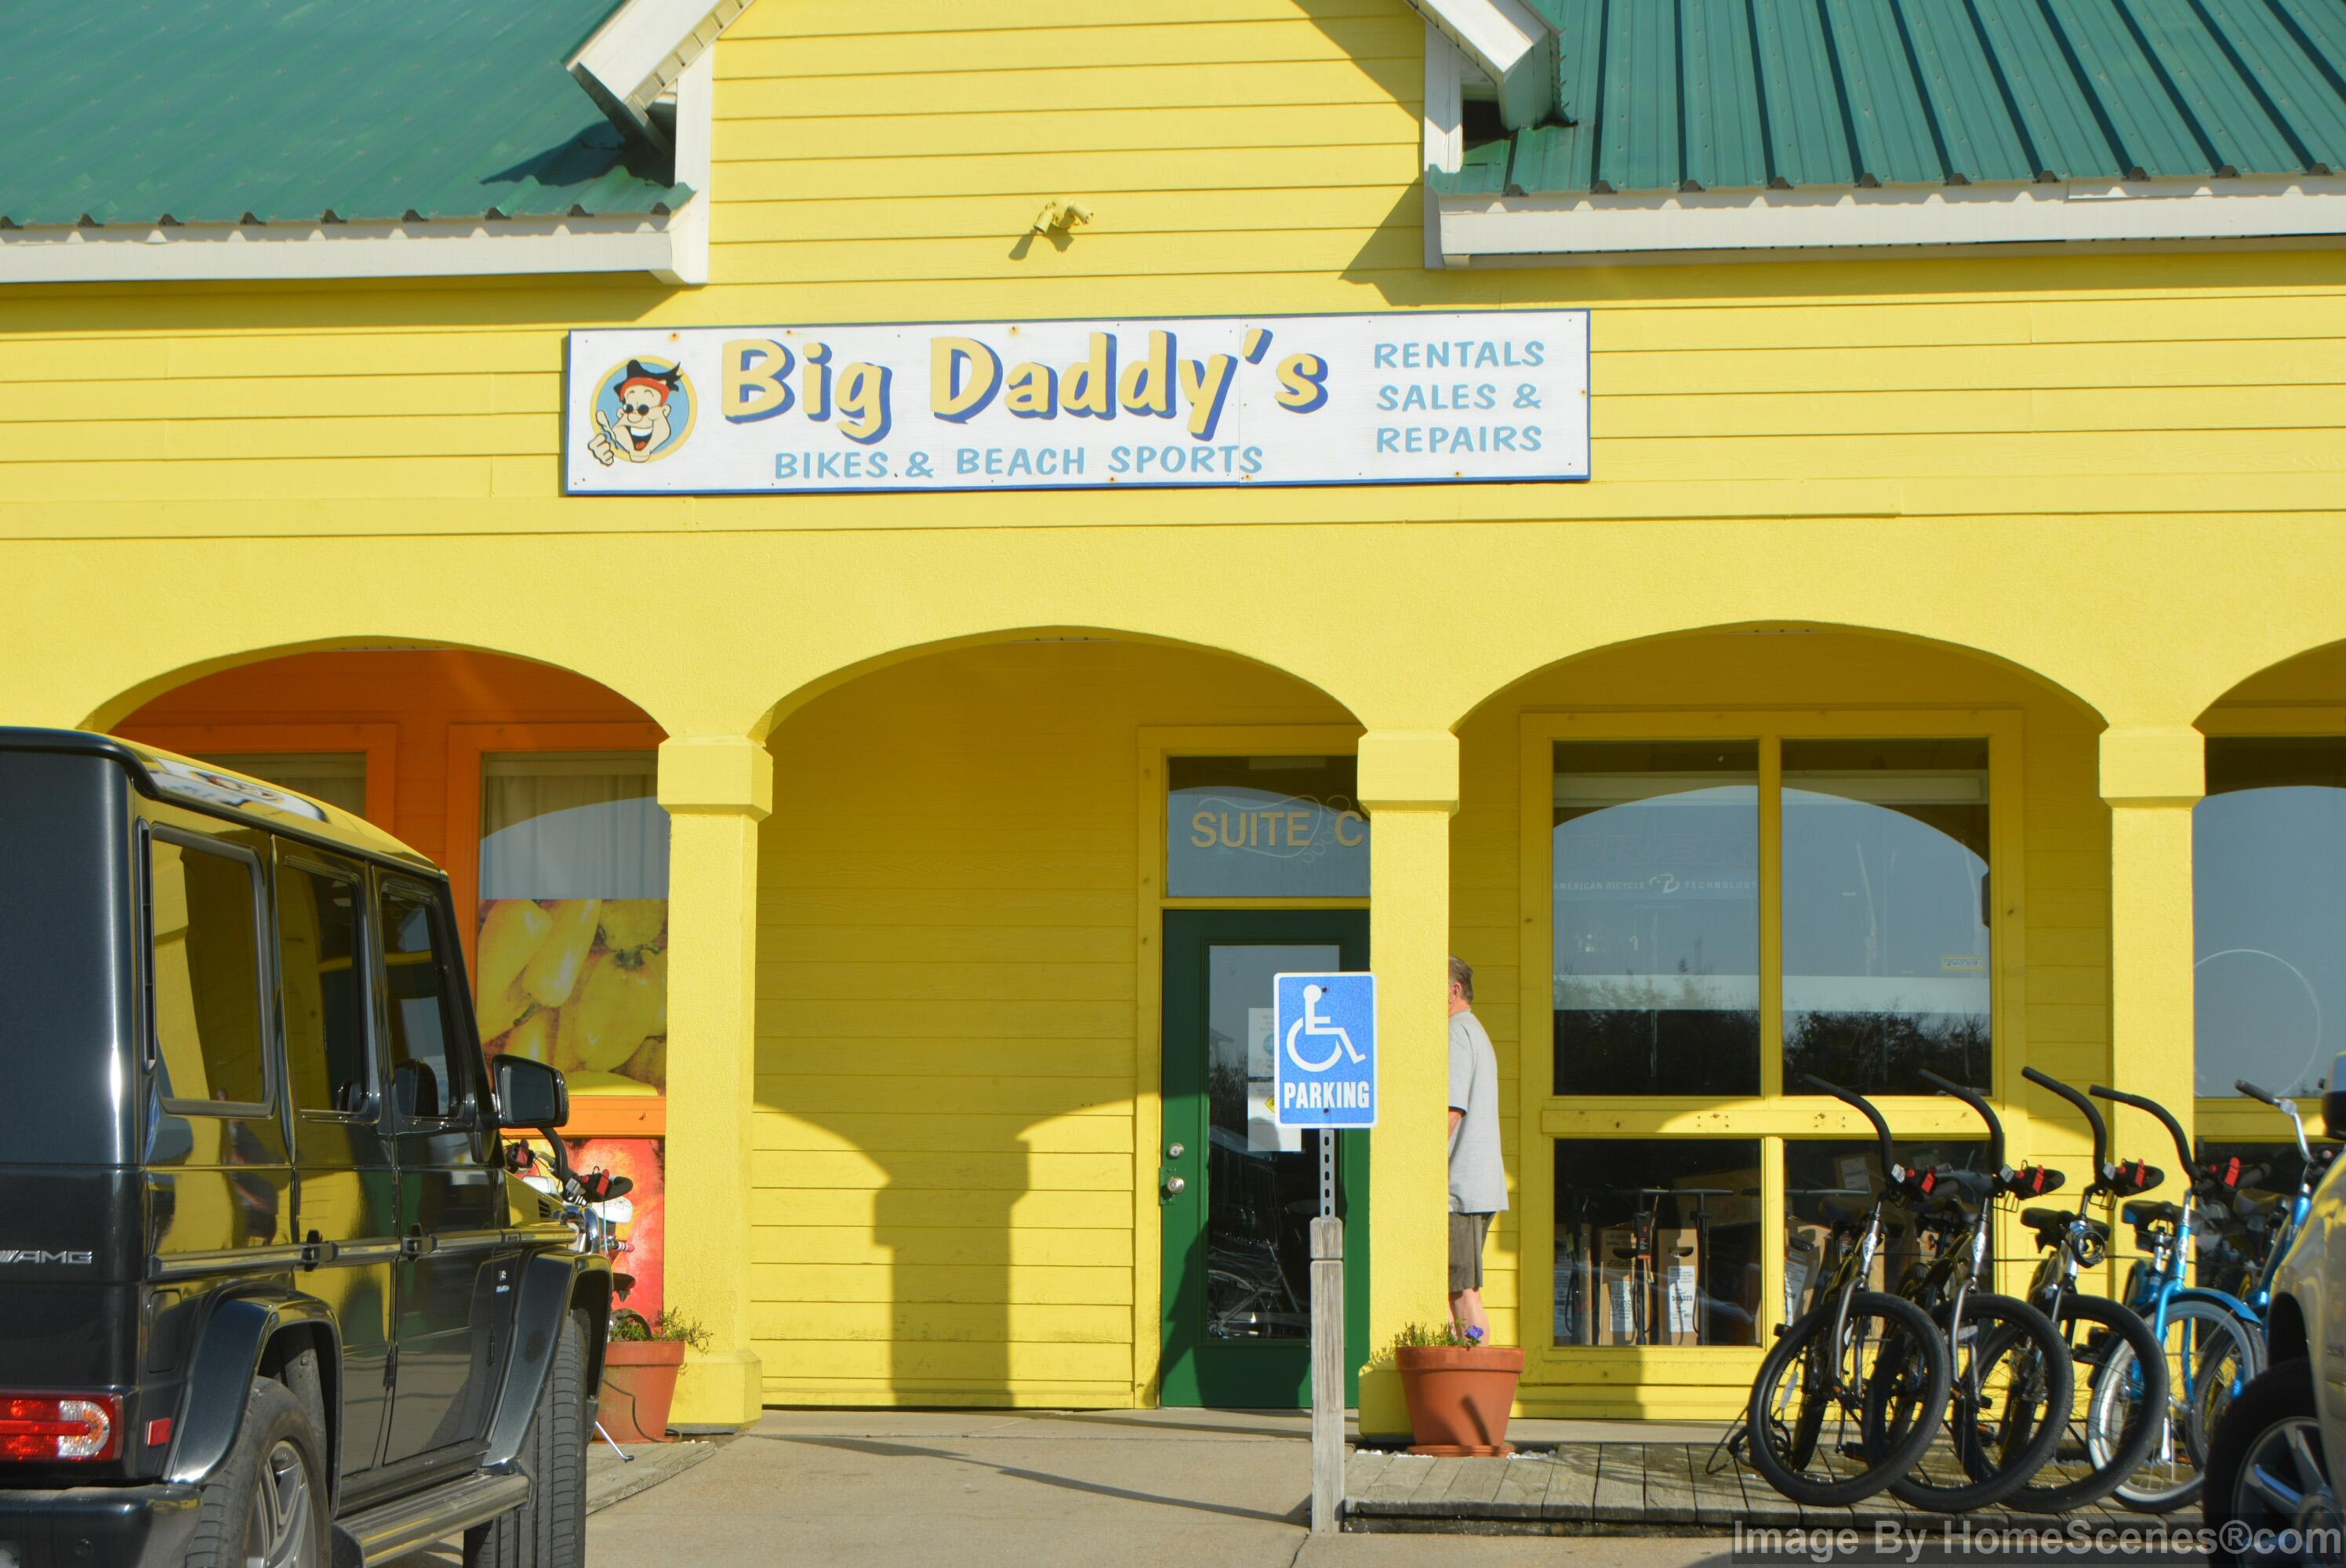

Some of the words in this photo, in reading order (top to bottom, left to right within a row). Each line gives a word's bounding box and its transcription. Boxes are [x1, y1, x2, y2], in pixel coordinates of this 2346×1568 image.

[1375, 341, 1545, 369] RENTALS
[721, 339, 892, 445] Big
[930, 328, 1328, 441] Daddy's
[1376, 383, 1496, 412] SALES
[1513, 383, 1542, 409] &
[1377, 425, 1542, 454] REPAIRS
[775, 452, 888, 479] BIKES
[906, 452, 935, 478] &
[956, 448, 1085, 477] BEACH
[1108, 445, 1263, 474] SPORTS
[1191, 811, 1311, 848] SUITE
[1335, 811, 1364, 848] C
[1284, 1081, 1370, 1109] PARKING
[13, 1250, 92, 1264] AMG
